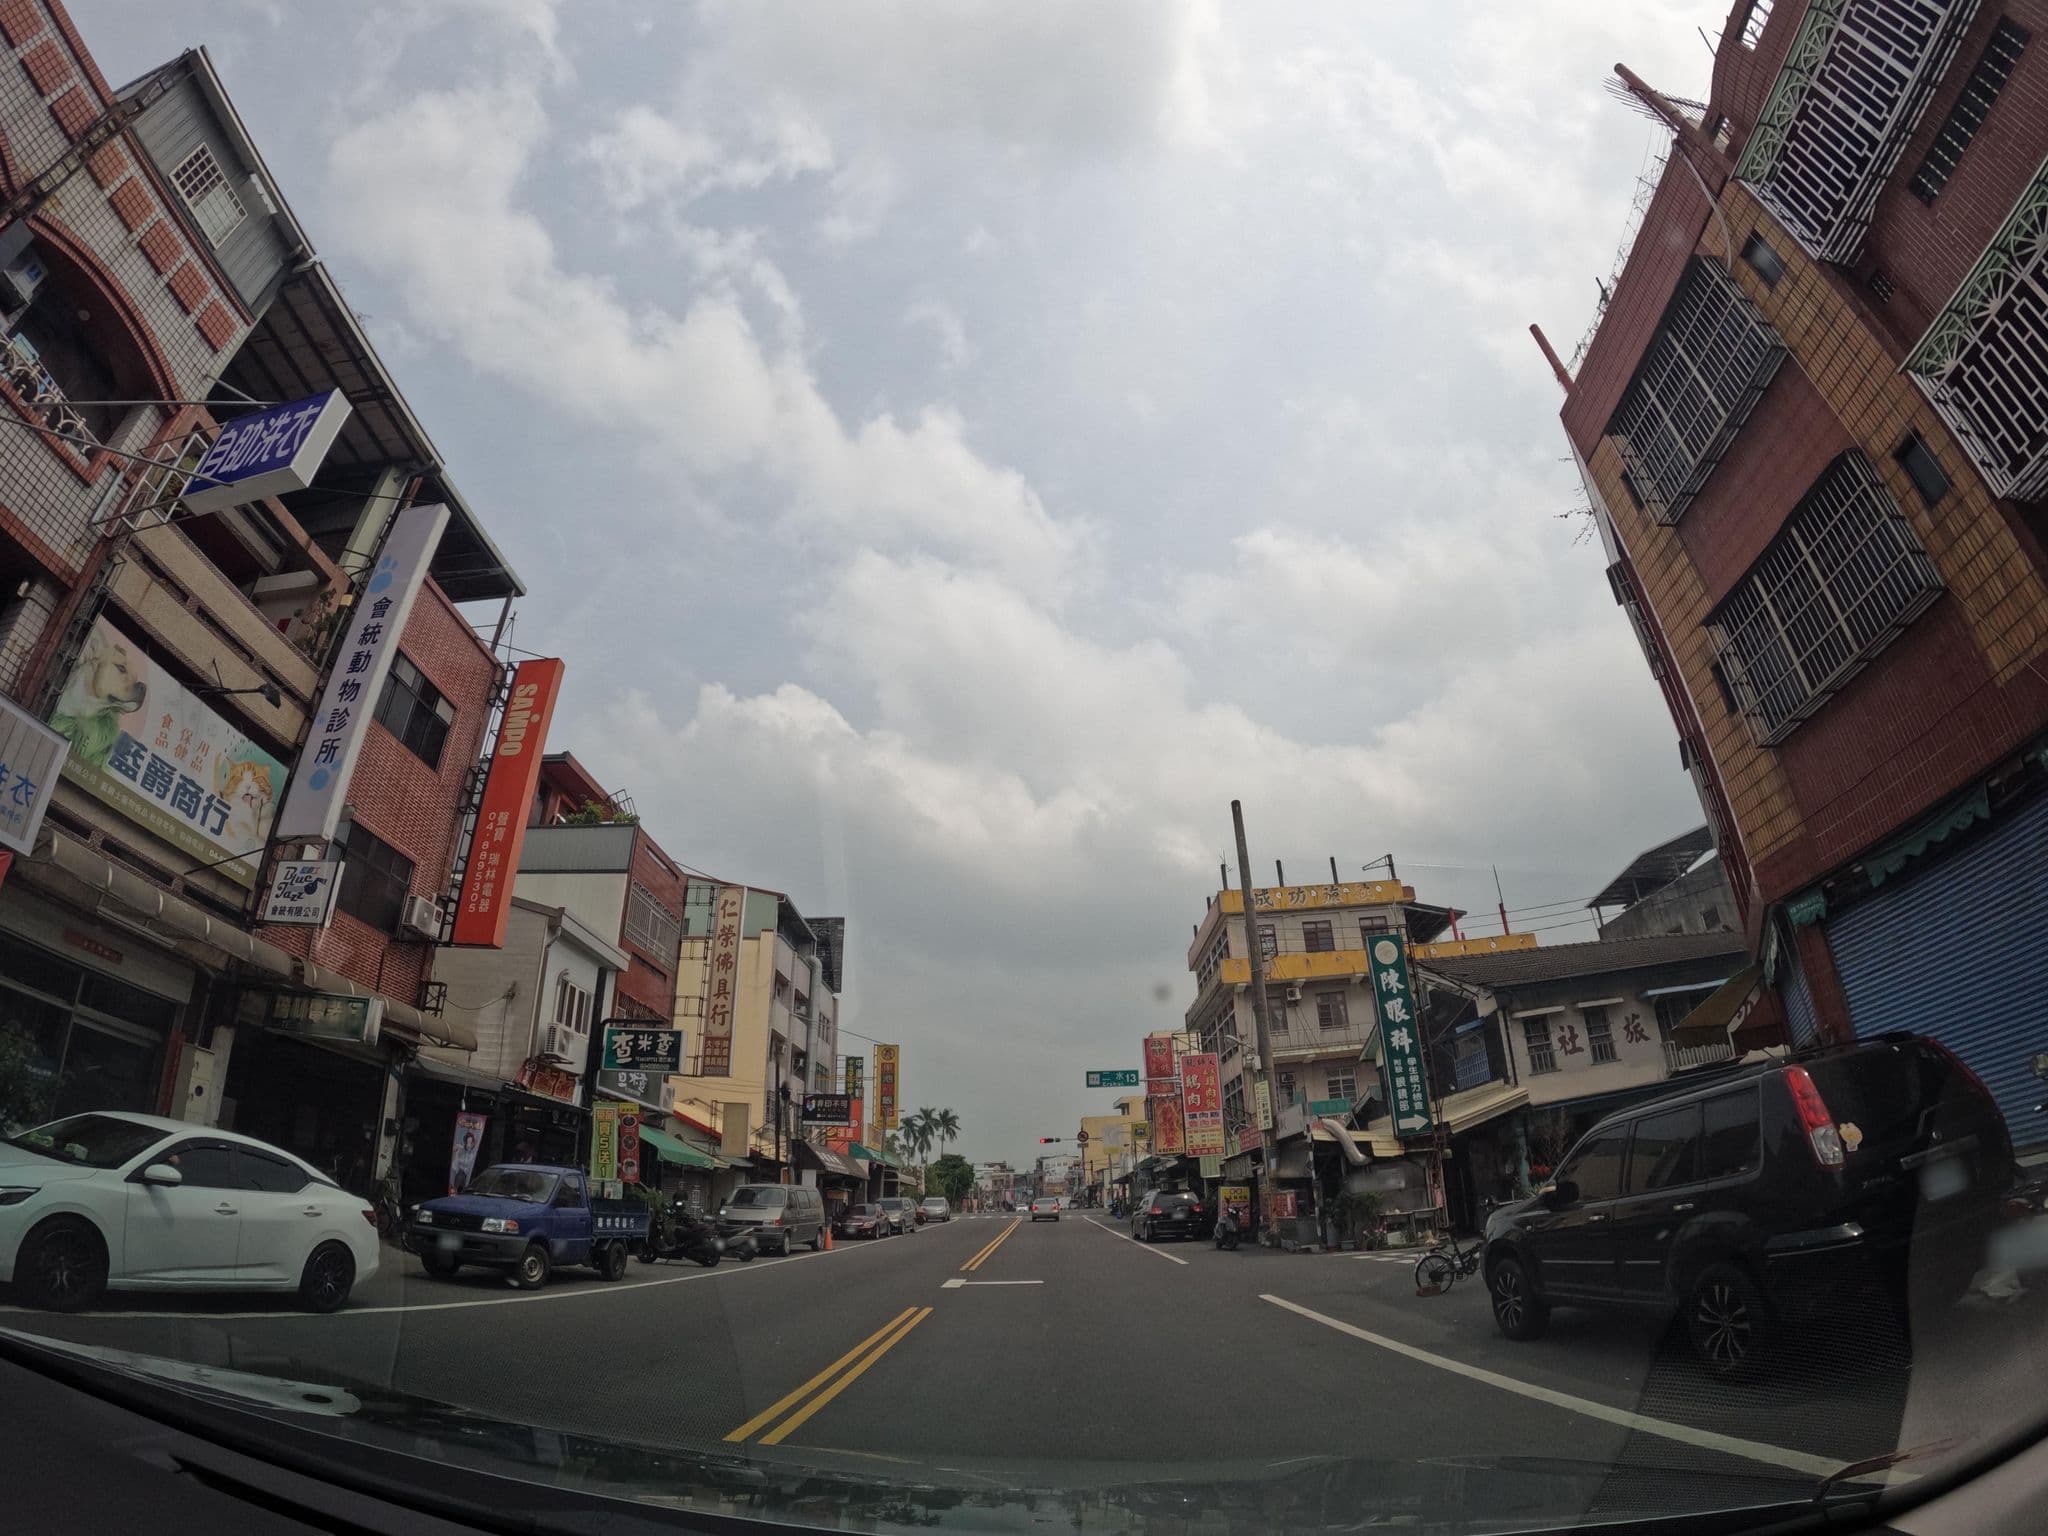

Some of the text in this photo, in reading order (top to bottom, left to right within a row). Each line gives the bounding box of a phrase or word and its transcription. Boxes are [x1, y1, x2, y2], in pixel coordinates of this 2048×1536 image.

[196, 405, 321, 481] 自助洗衣
[314, 597, 393, 764] 會統動物診所
[499, 683, 540, 757] SAMPO
[108, 730, 232, 836] 藍爵商行
[274, 882, 305, 902] Jazz
[284, 866, 313, 885] Blue
[478, 852, 501, 913] 瑞林電器
[710, 899, 738, 1026] 仁榮佛具行
[1380, 969, 1414, 1055] 陳眼科
[1126, 1073, 1137, 1083] 13
